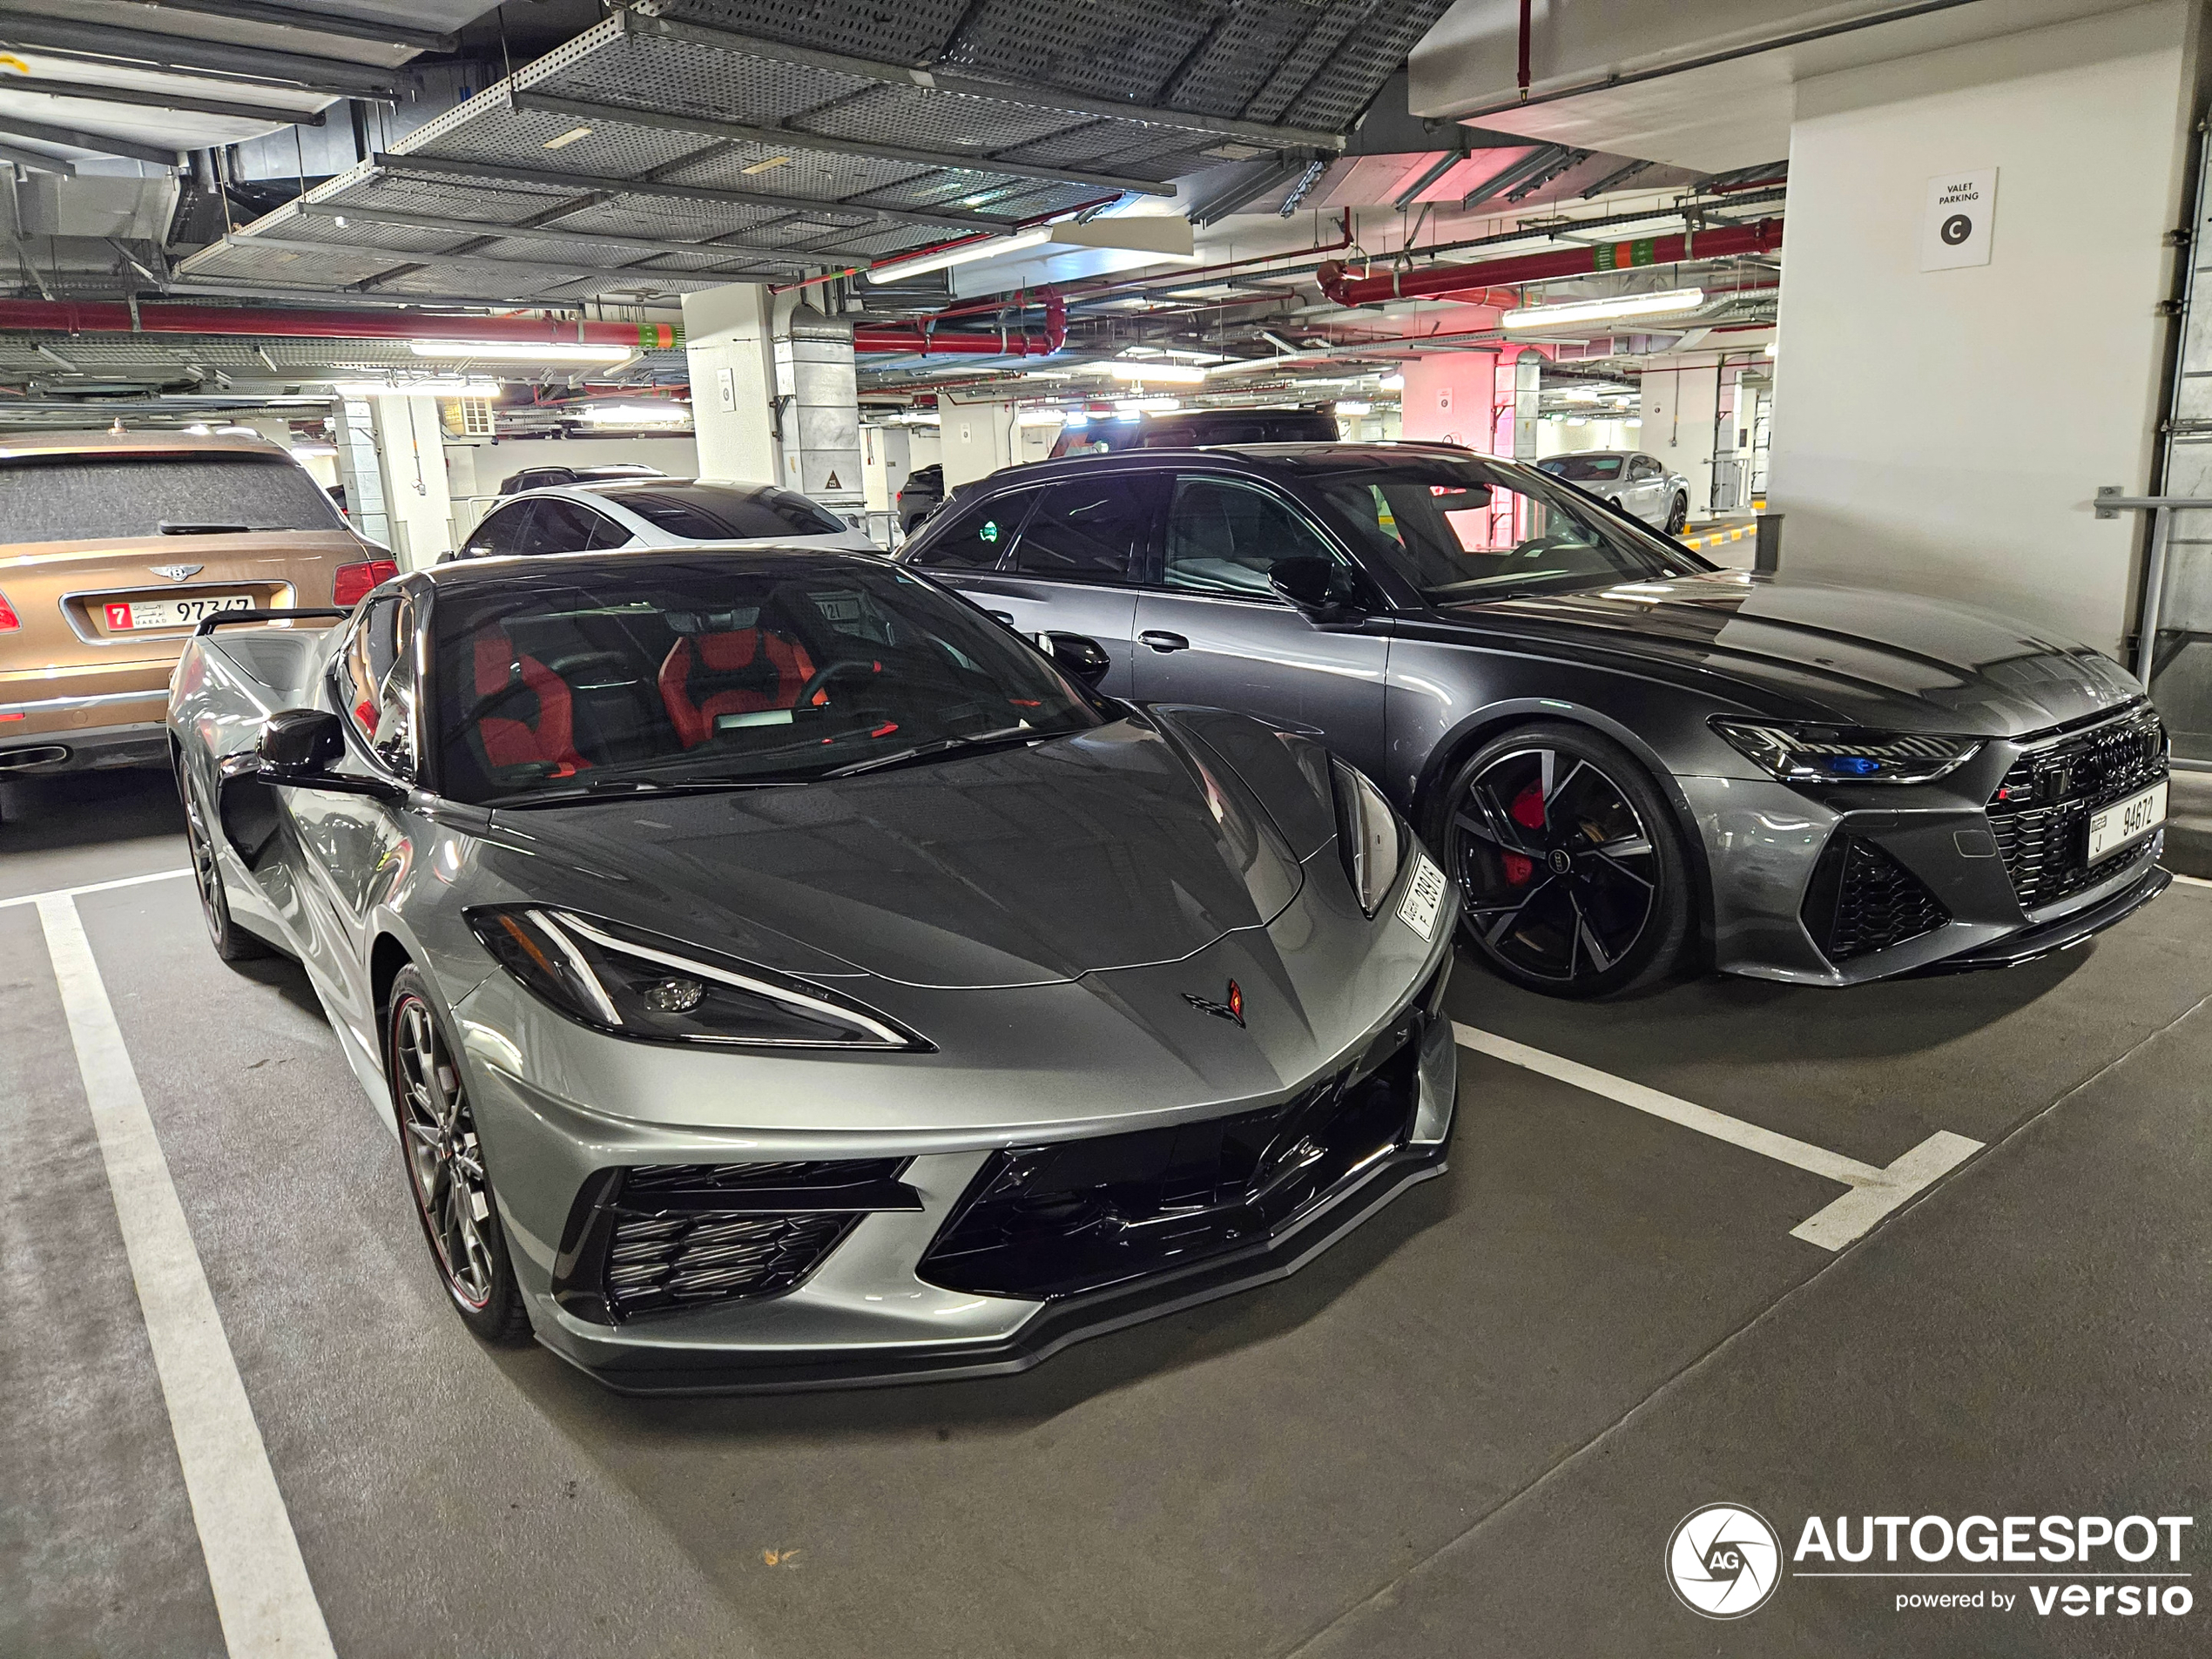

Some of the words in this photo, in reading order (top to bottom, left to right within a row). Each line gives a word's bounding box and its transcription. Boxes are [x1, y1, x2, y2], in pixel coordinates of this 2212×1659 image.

[1947, 182, 1973, 193] VALET
[1939, 192, 1979, 205] PARKING
[1948, 220, 1963, 239] C
[112, 608, 125, 625] 7
[2123, 795, 2154, 837] 94672
[2095, 833, 2102, 853] J
[1414, 865, 1441, 910] 29916
[1420, 914, 1431, 928] F
